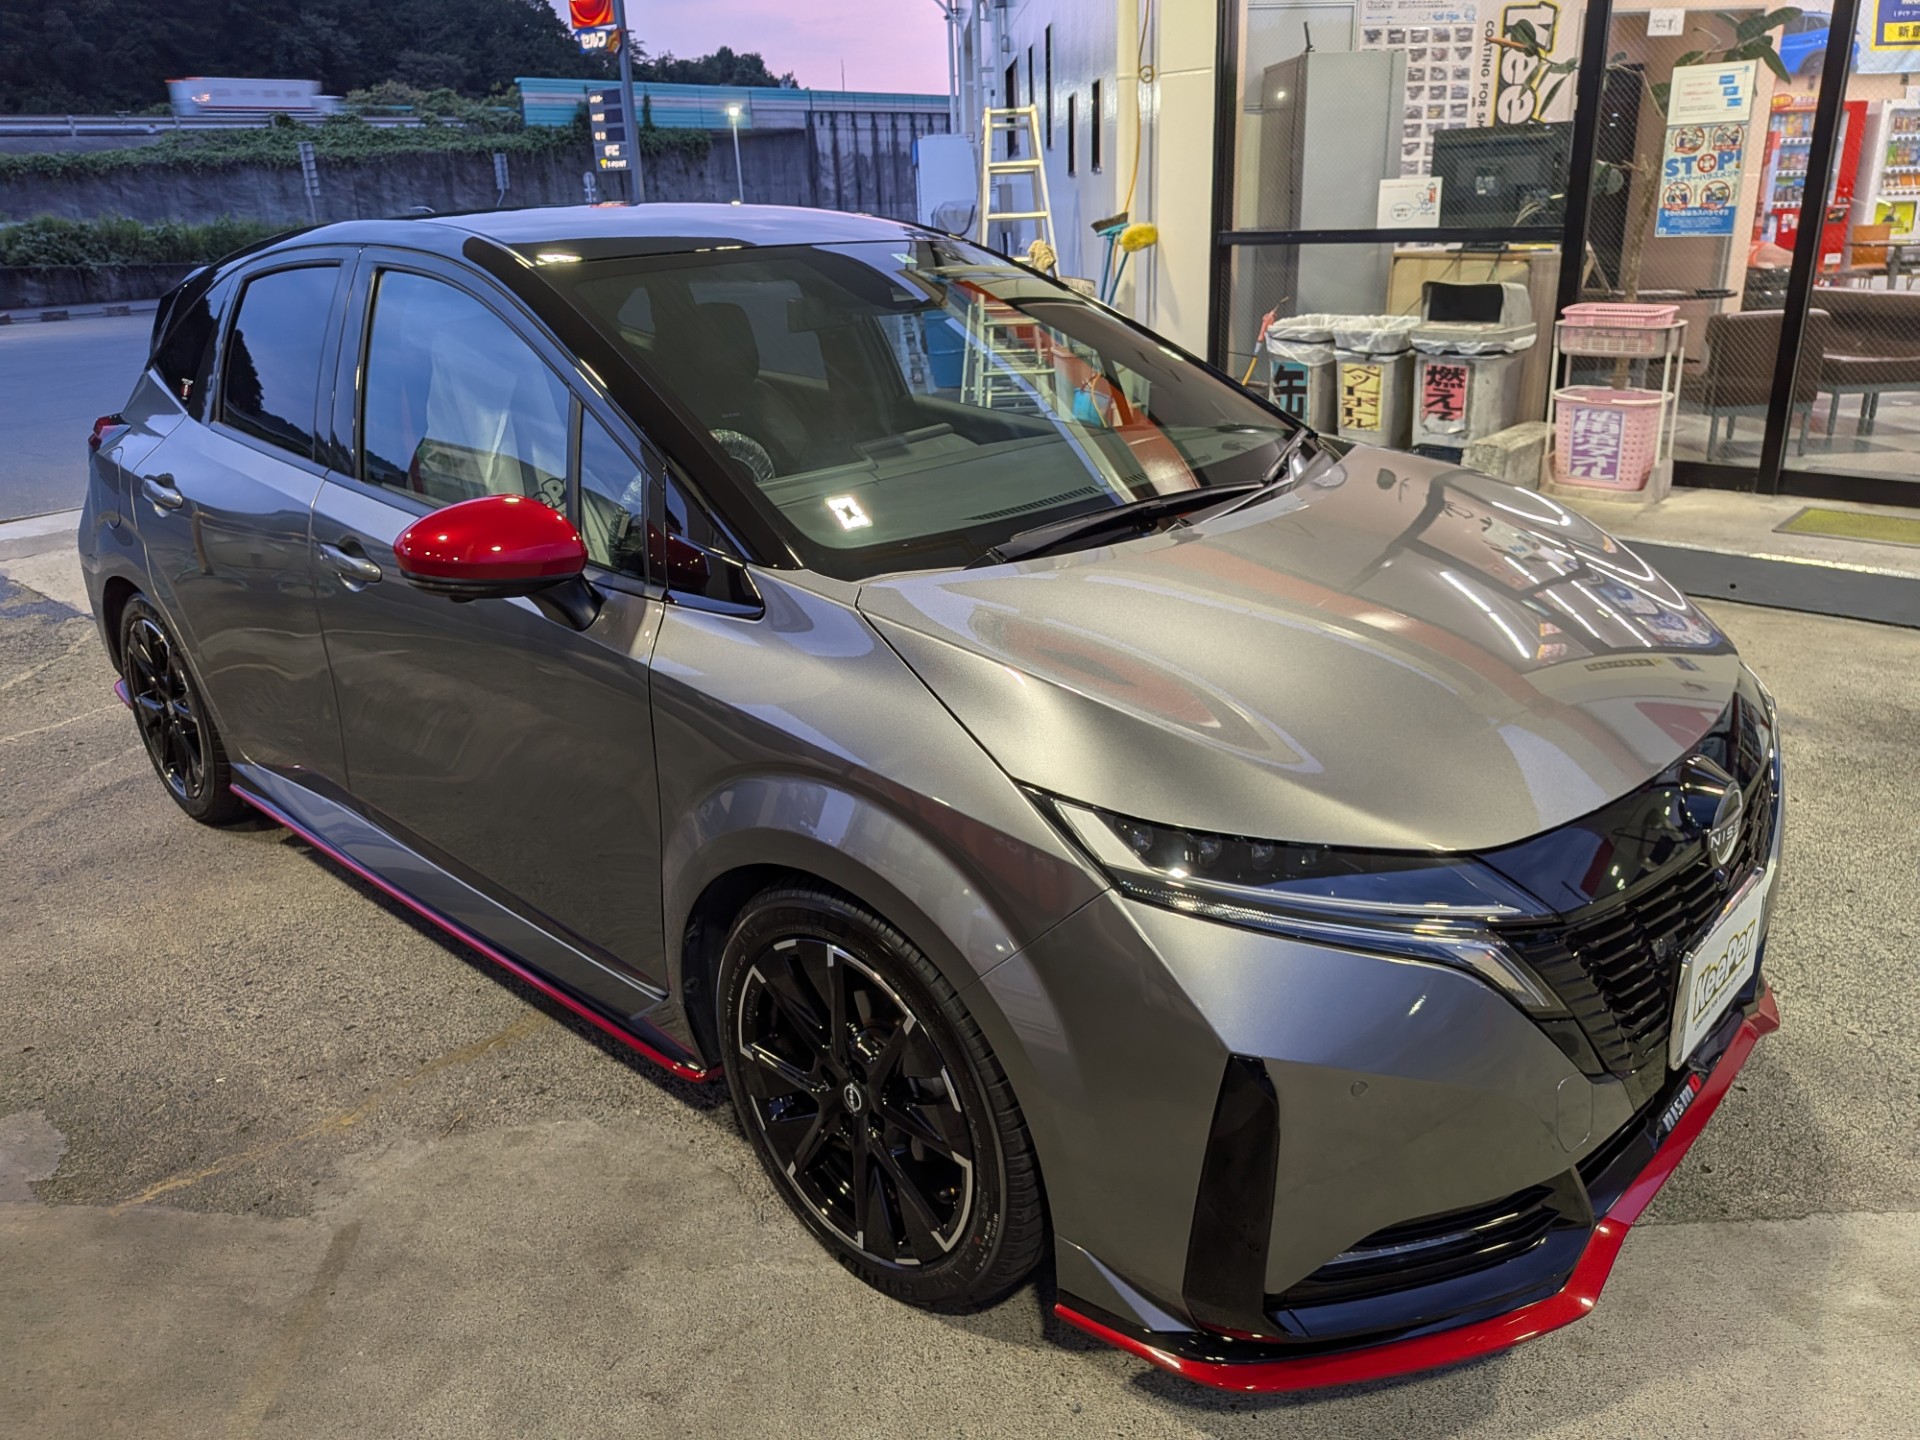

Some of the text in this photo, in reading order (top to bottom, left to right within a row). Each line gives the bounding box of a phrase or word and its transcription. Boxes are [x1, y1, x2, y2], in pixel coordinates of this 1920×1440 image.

[580, 31, 607, 49] セルフ
[1478, 83, 1489, 107] FOR
[1692, 918, 1756, 1022] KeePer
[1662, 1073, 1702, 1132] nismo
